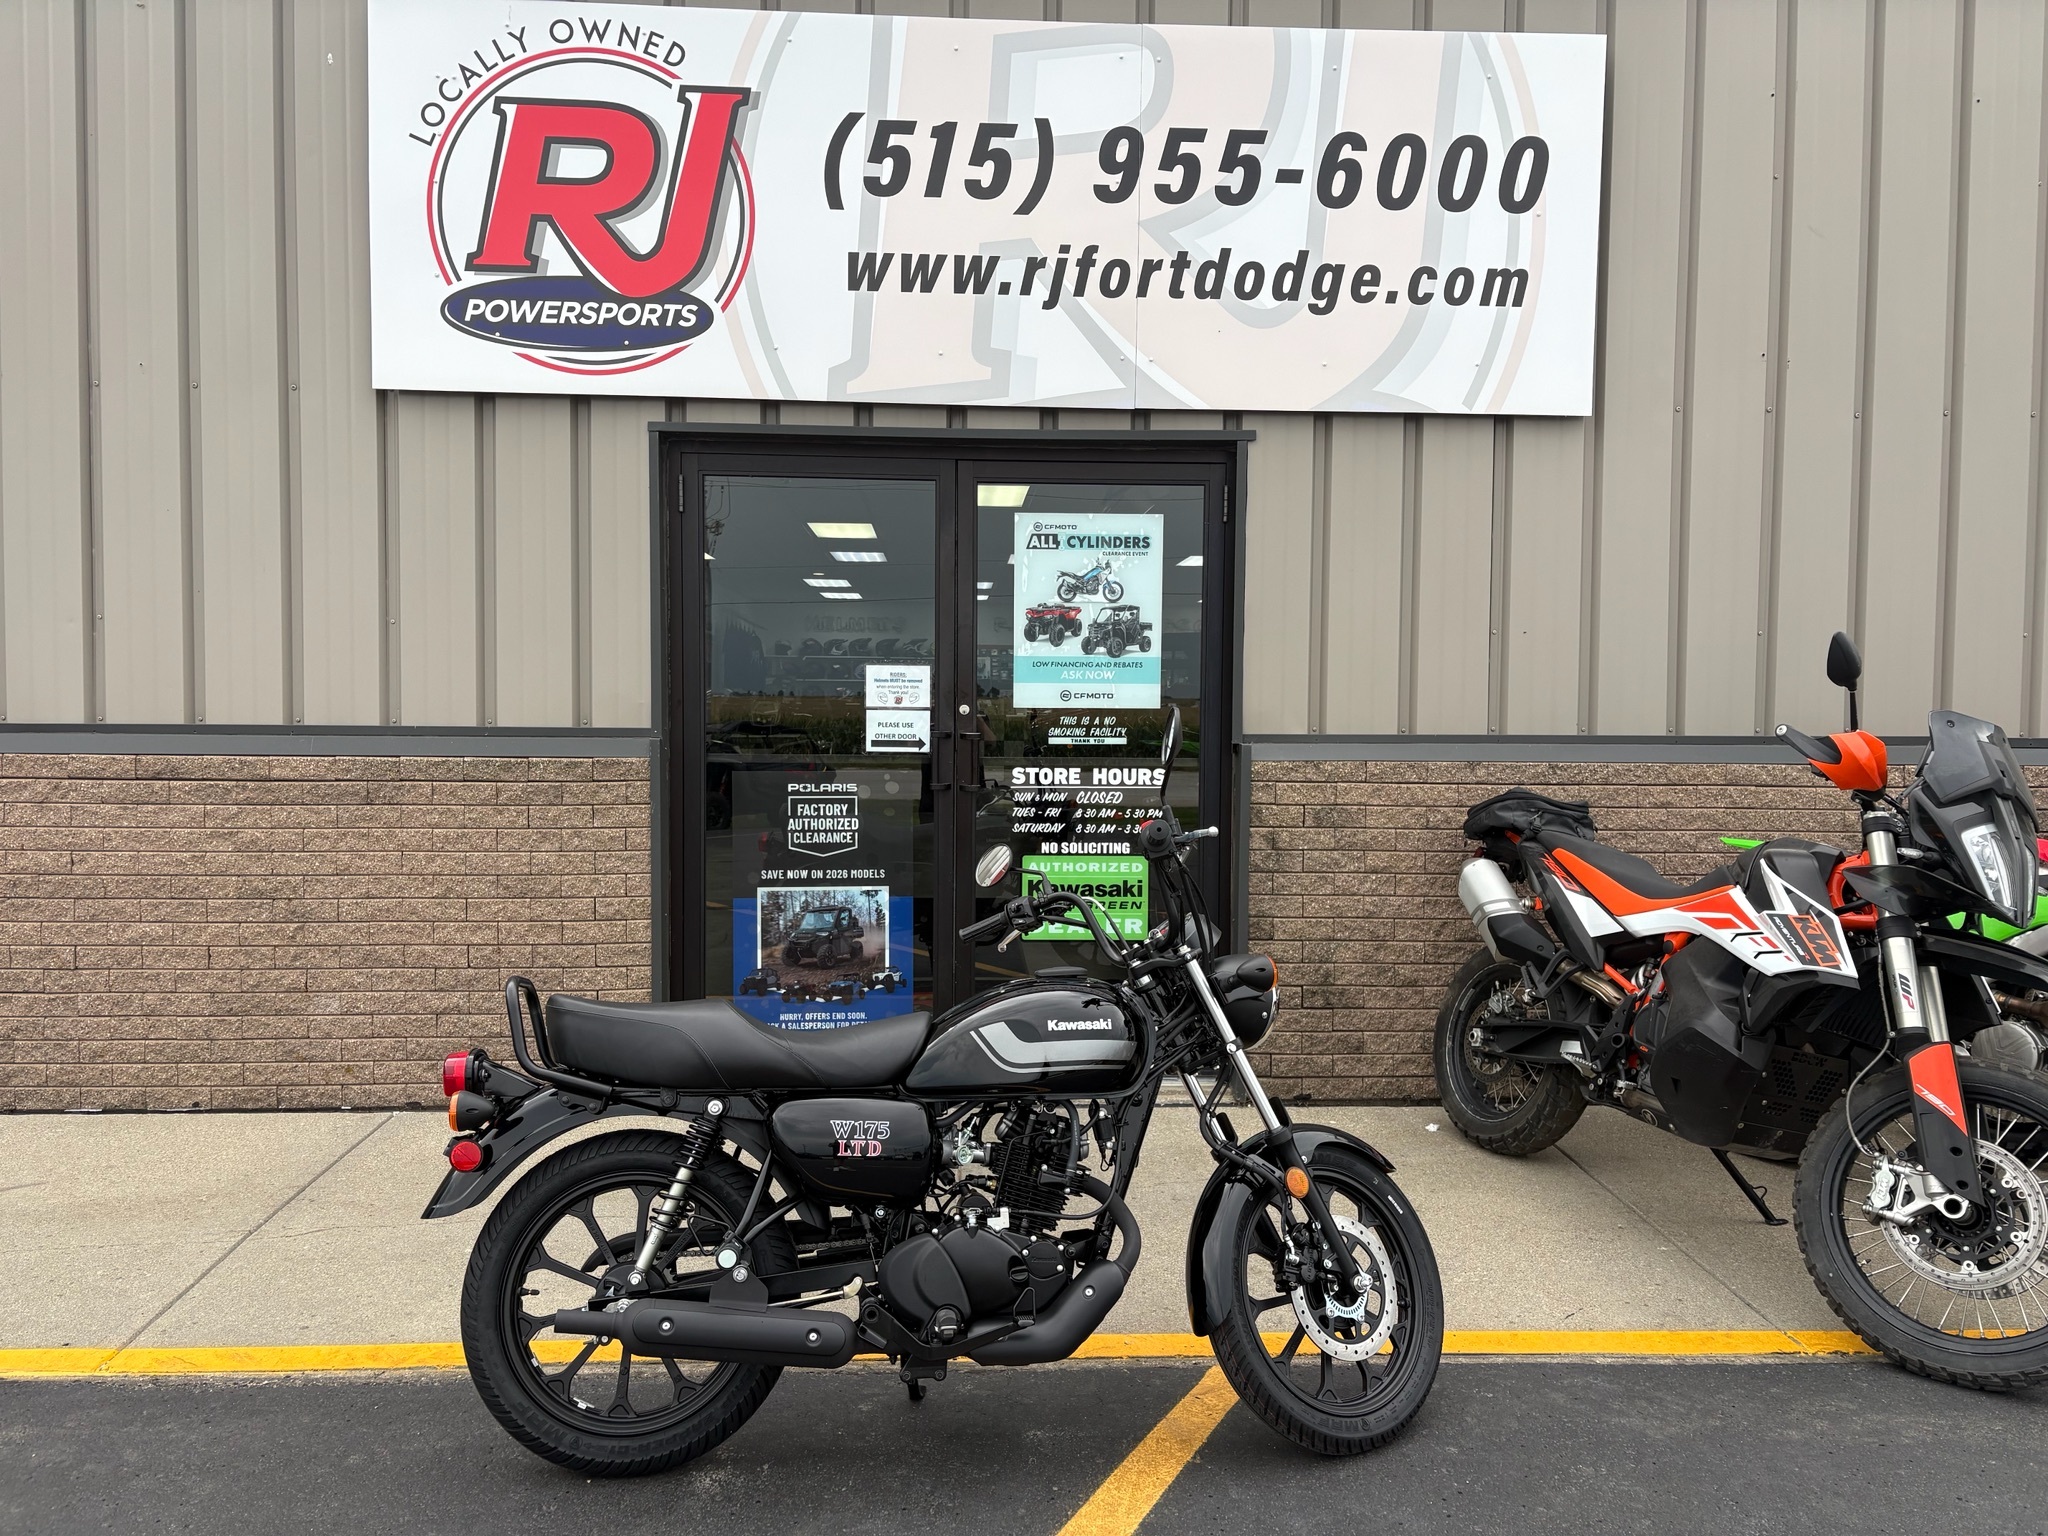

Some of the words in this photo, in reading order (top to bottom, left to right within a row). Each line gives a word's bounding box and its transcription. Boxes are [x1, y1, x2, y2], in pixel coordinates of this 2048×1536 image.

[408, 26, 528, 147] LOCALLY
[548, 17, 687, 68] OWNED
[823, 112, 1055, 216] (515)
[1093, 126, 1550, 214] 955-6000
[465, 86, 756, 299] RJ
[847, 244, 1530, 316] www.rjfortdodge.com
[464, 298, 699, 329] POWERSPORTS
[1029, 535, 1057, 549] ALL
[1066, 535, 1151, 549] CYLINDERS
[1113, 661, 1143, 669] REBATES
[1060, 671, 1084, 680] ASK
[1085, 670, 1115, 680] NOW
[1073, 692, 1114, 700] CFMOTO
[1059, 716, 1078, 725] THIS
[1081, 717, 1090, 725] IS
[1093, 717, 1100, 725] A
[1104, 717, 1116, 726] NO
[1048, 727, 1087, 737] SMOKING
[1090, 727, 1127, 737] FACILITY
[1011, 767, 1082, 785] STORE
[1092, 768, 1166, 786] HOURS
[788, 783, 858, 792] POLARIS
[1012, 792, 1035, 802] SUN
[1041, 792, 1067, 802] MON
[1075, 791, 1123, 804] CLOSED
[797, 803, 848, 816] FACTORY
[1012, 807, 1036, 817] TUES
[1044, 807, 1062, 817] FRI
[1098, 808, 1116, 818] AM
[1146, 808, 1163, 818] PM
[787, 818, 859, 830] AUTHORIZED
[1012, 823, 1065, 833] SATURDAY
[1097, 823, 1116, 833] AM
[793, 832, 853, 843] CLEARANCE
[1041, 842, 1059, 854] NO
[1061, 842, 1131, 854] SOLICITING
[1029, 862, 1143, 873] AUTHORIZED
[761, 870, 784, 880] SAVE
[787, 870, 808, 879] NOW
[811, 870, 823, 879] ON
[826, 869, 848, 879] 2026
[850, 869, 885, 879] MODELS
[1788, 914, 1841, 967] KTM
[780, 1013, 804, 1021] HURRY,
[805, 1012, 831, 1020] OFFERS
[832, 1012, 845, 1020] END
[847, 1012, 868, 1020] SOON.
[787, 1022, 835, 1030] SALESPERSON
[1047, 1018, 1112, 1031] Kawasaki
[1915, 1083, 1956, 1116] 790
[830, 1119, 890, 1139] W175
[837, 1139, 882, 1156] LTD
